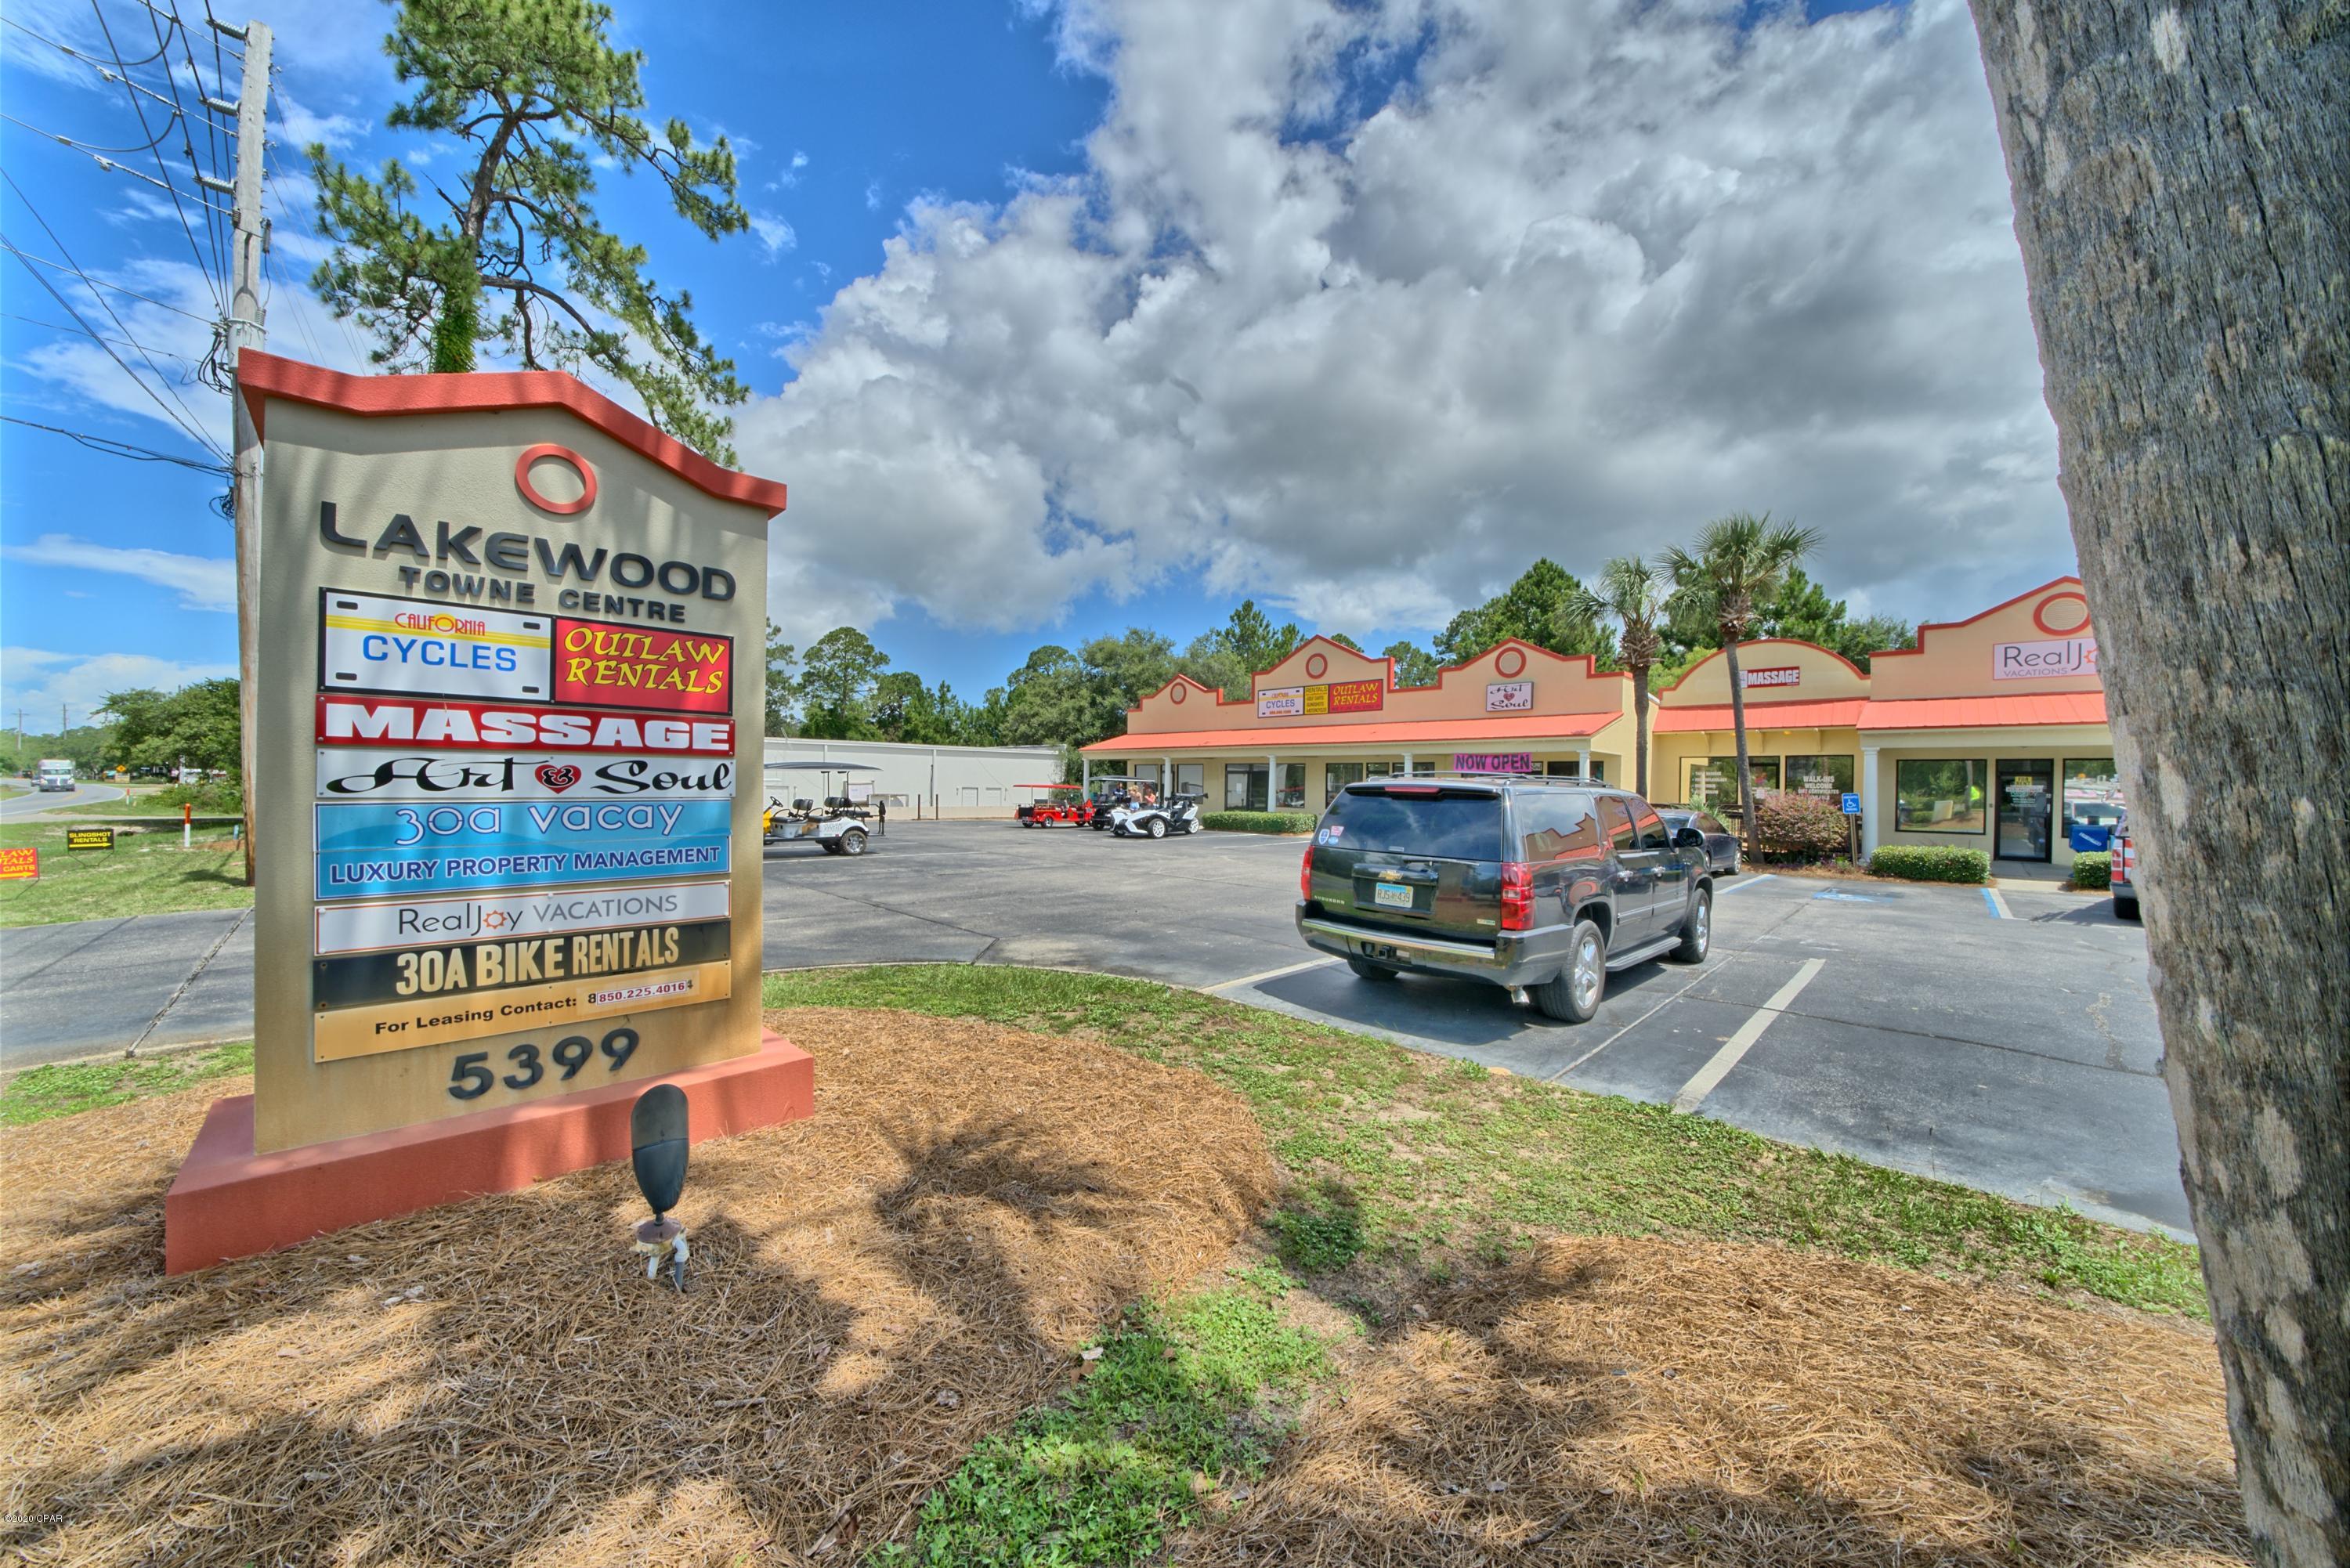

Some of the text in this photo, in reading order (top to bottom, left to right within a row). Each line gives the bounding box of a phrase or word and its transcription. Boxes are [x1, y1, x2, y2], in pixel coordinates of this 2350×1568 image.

[320, 500, 736, 602] LAKEWOOD
[399, 565, 686, 623] TOWNE CENTRE
[395, 613, 486, 636] CALIFORNIA
[363, 635, 517, 672] CYCLES
[563, 627, 728, 665] OUTLAW
[2004, 641, 2097, 671] RealJ
[564, 657, 724, 694] RENTALS
[1333, 682, 1378, 695] OUTLAW
[1748, 670, 1799, 685] MASSAGE
[2004, 667, 2068, 677] VACATIONS
[1266, 699, 1296, 709] CYCLES
[1334, 693, 1378, 705] RENTALS
[325, 703, 730, 751] MASSAGE
[326, 757, 550, 793] Art
[590, 760, 732, 795] Soul
[1455, 755, 1487, 769] NOW
[1491, 754, 1529, 770] OPEN
[395, 807, 501, 846] 30a
[330, 847, 721, 884] LUXURY PROPERTY MANAGEMENT
[533, 895, 678, 923] VACATIONS
[396, 927, 680, 995] 30A BIKE RENTALS
[598, 982, 685, 1003] 850.225.4016
[375, 1021, 410, 1035] For
[416, 1009, 494, 1028] Leasing
[501, 997, 577, 1016] Contact:
[448, 1028, 640, 1101] 5399
